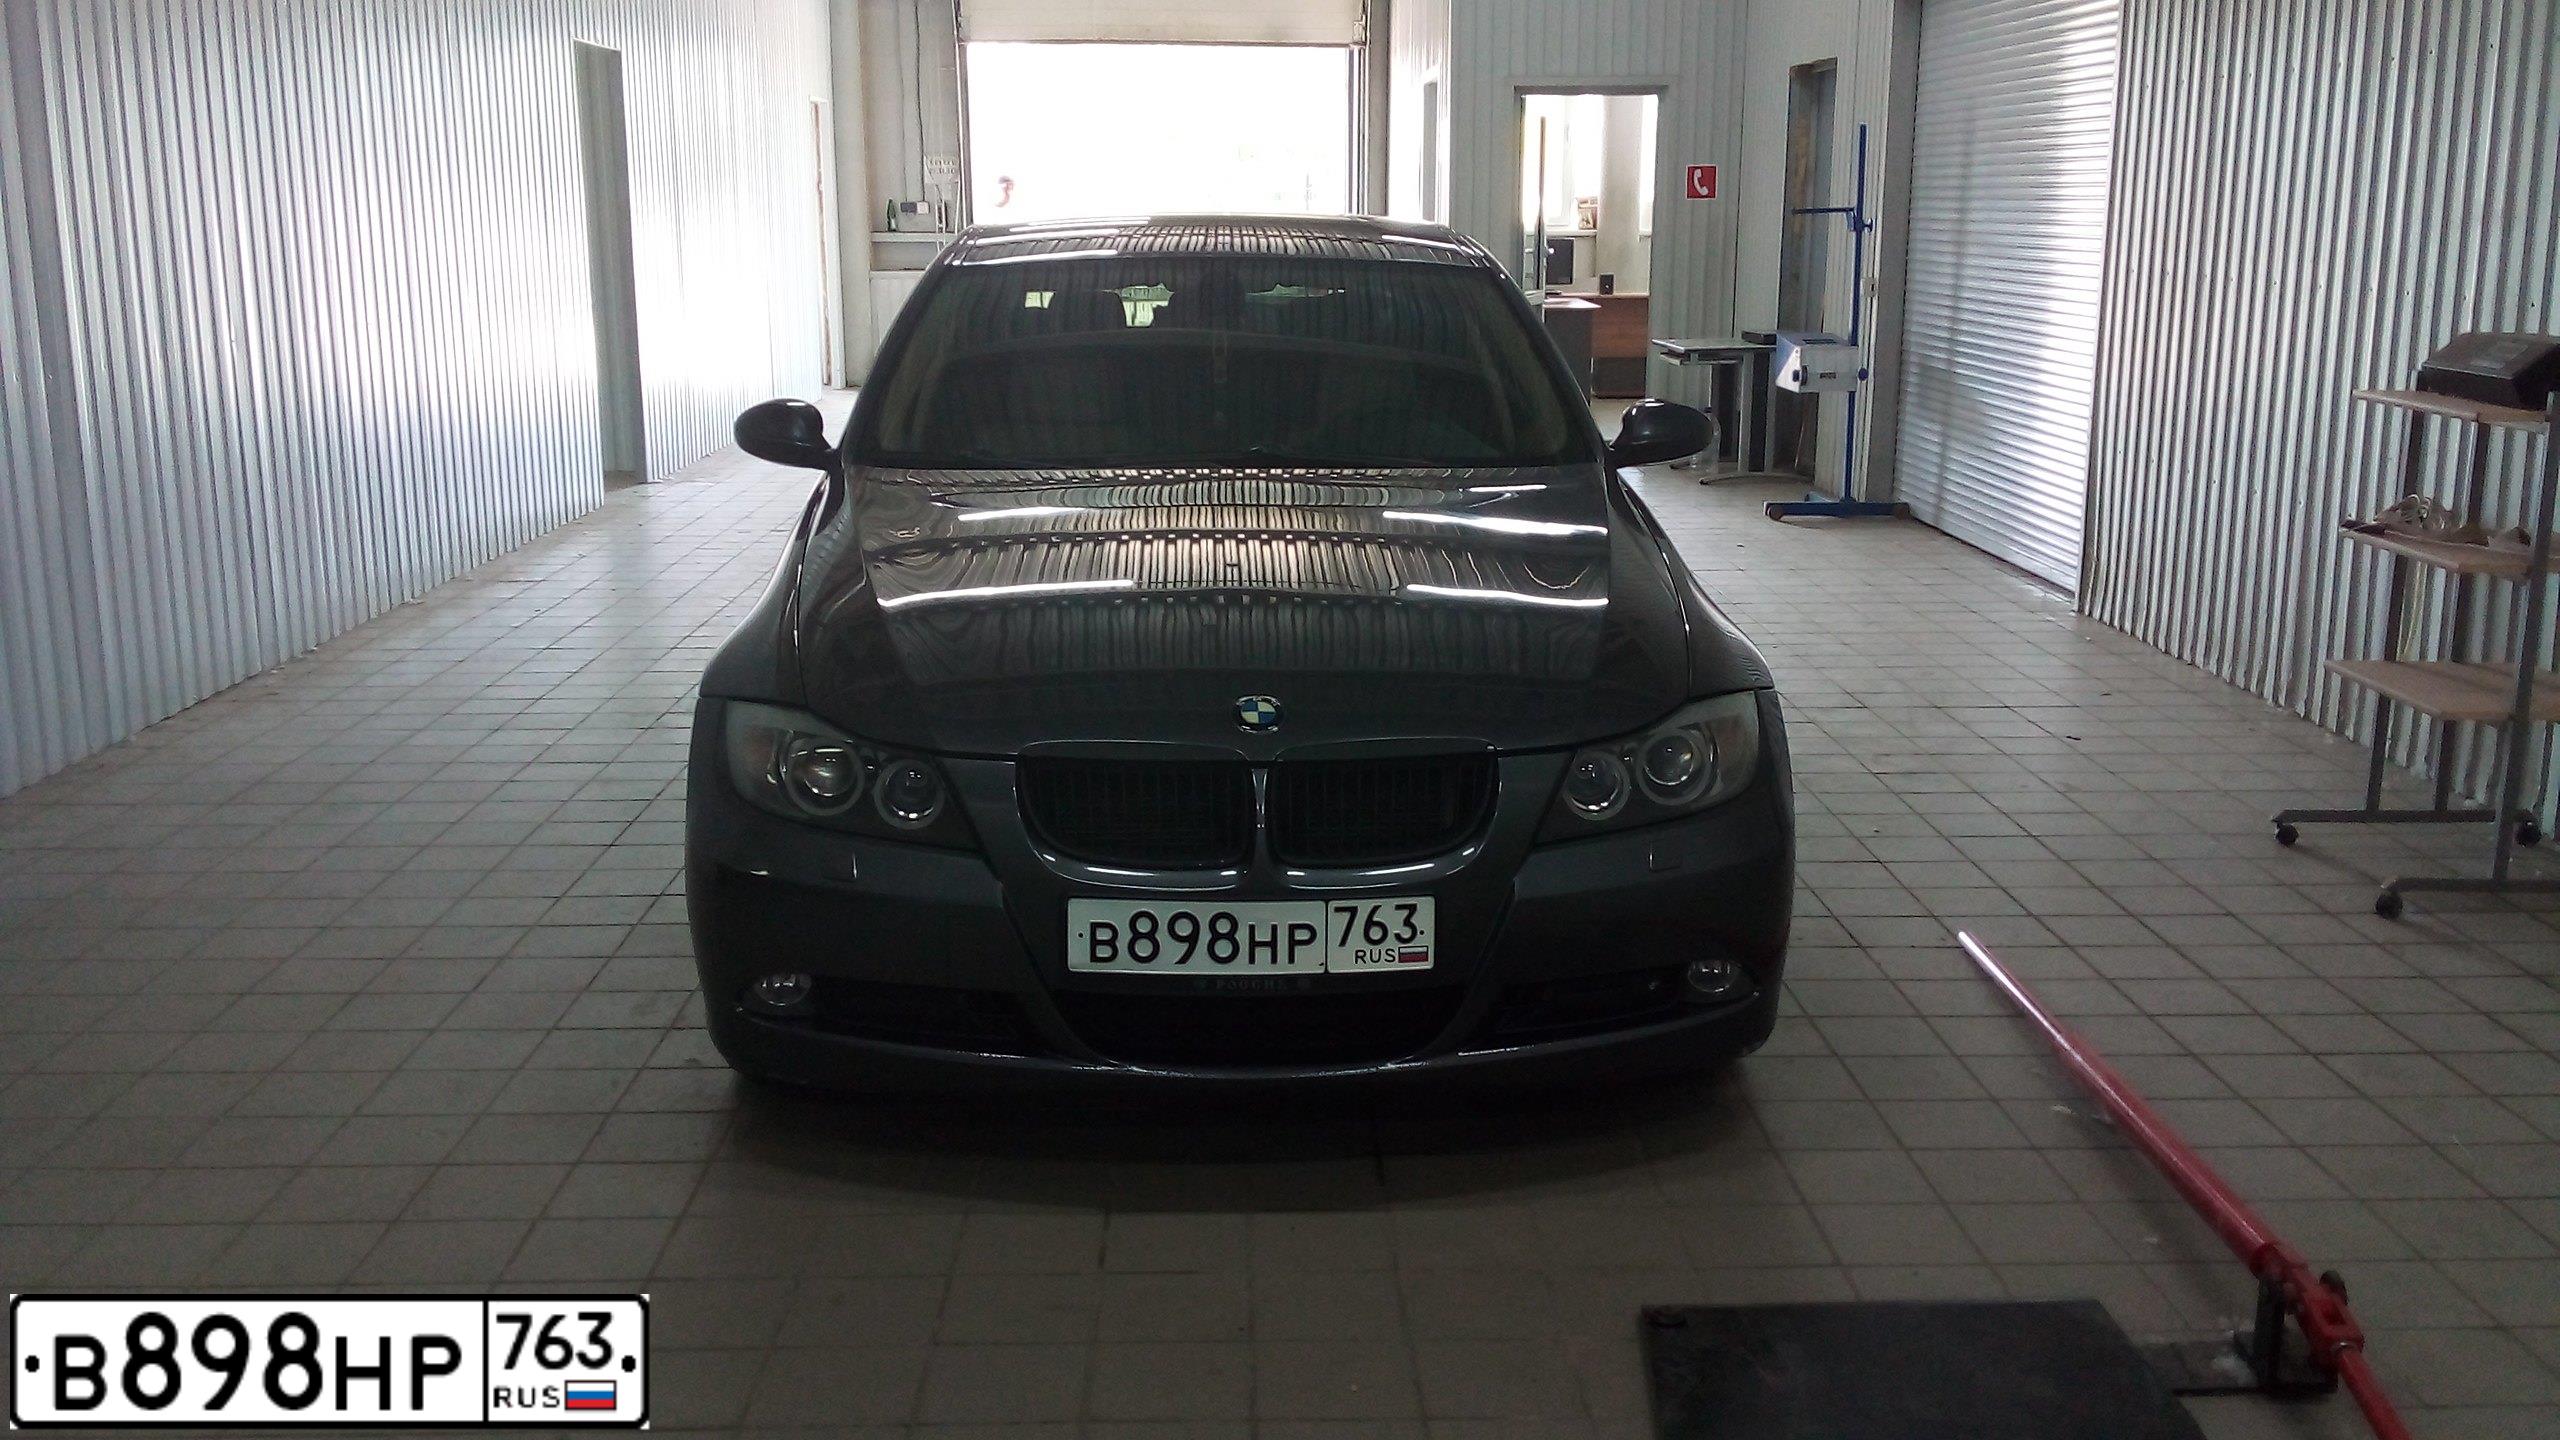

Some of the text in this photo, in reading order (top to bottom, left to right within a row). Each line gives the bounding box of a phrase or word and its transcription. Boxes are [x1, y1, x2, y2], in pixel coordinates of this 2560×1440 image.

[1089, 903, 1419, 965] В898НР 763
[1354, 948, 1396, 965] RUS
